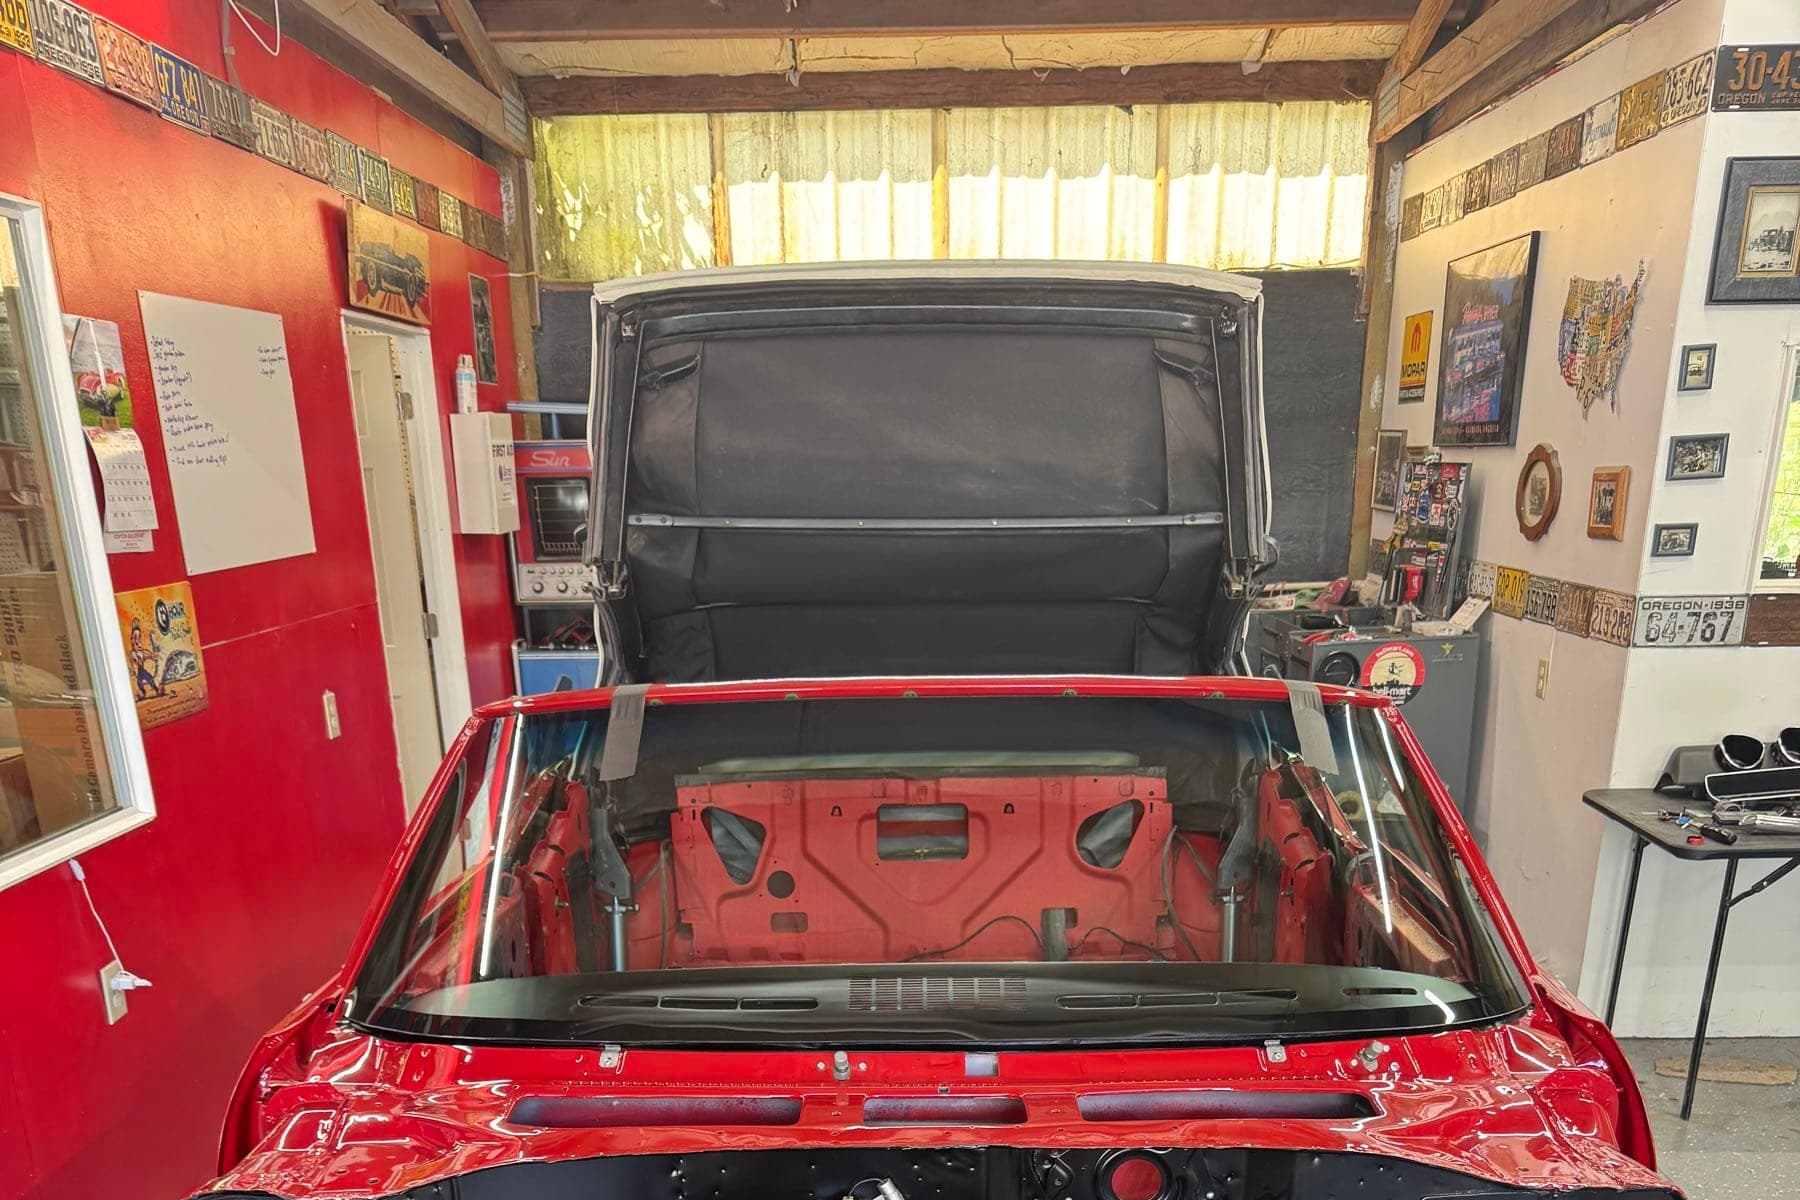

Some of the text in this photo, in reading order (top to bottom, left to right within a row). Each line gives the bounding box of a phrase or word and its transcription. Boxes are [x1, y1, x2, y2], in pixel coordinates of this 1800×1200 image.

[1718, 93, 1766, 104] OREGON
[1401, 361, 1426, 377] MOPAR
[530, 450, 571, 467] Sun
[1645, 612, 1734, 642] 64-767
[55, 633, 74, 675] Black
